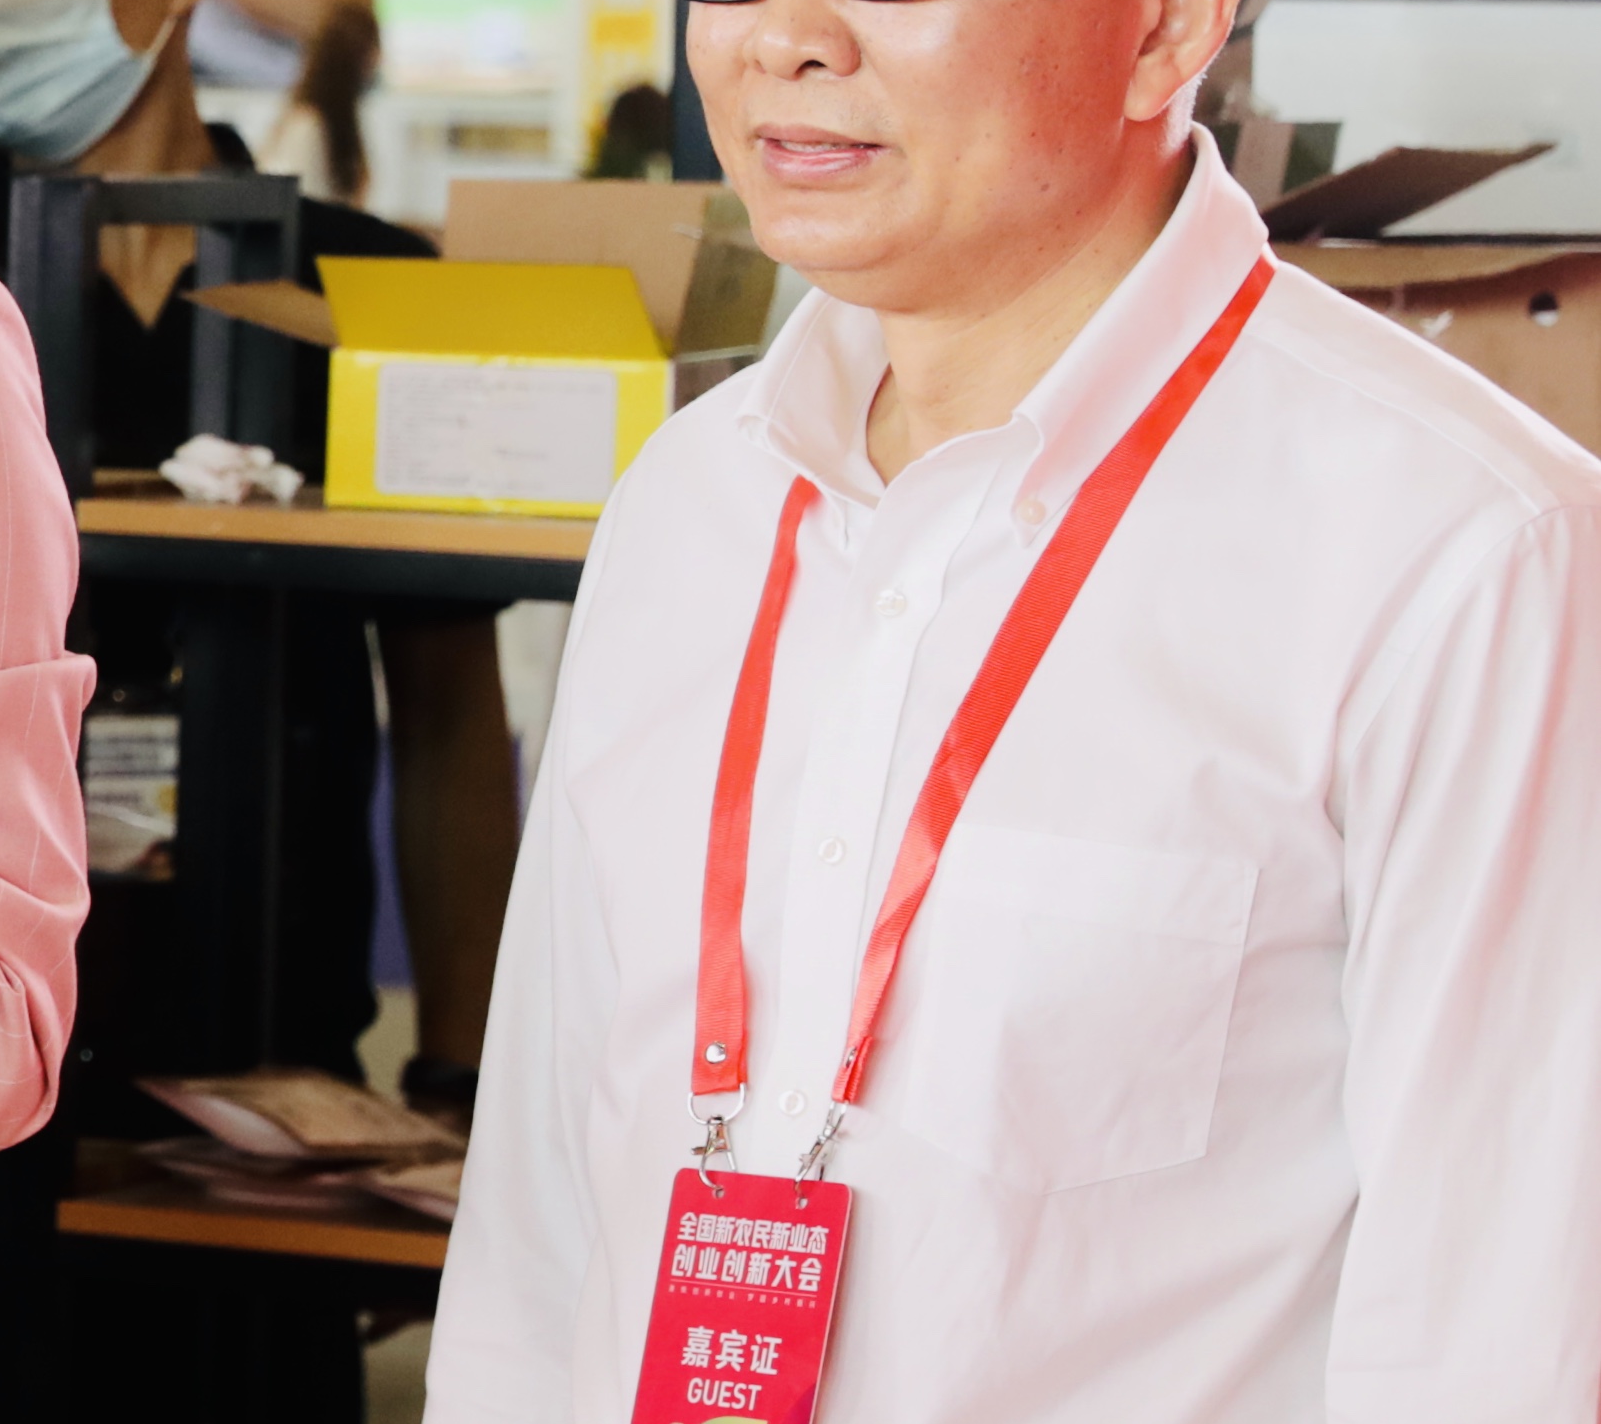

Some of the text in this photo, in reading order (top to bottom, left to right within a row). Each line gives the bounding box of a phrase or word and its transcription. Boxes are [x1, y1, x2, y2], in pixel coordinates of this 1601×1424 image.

[677, 1212, 829, 1255] 全国新农民新业态
[671, 1244, 822, 1292] 创业创新大会
[680, 1326, 783, 1375] 嘉宾证
[686, 1377, 762, 1411] GUEST
